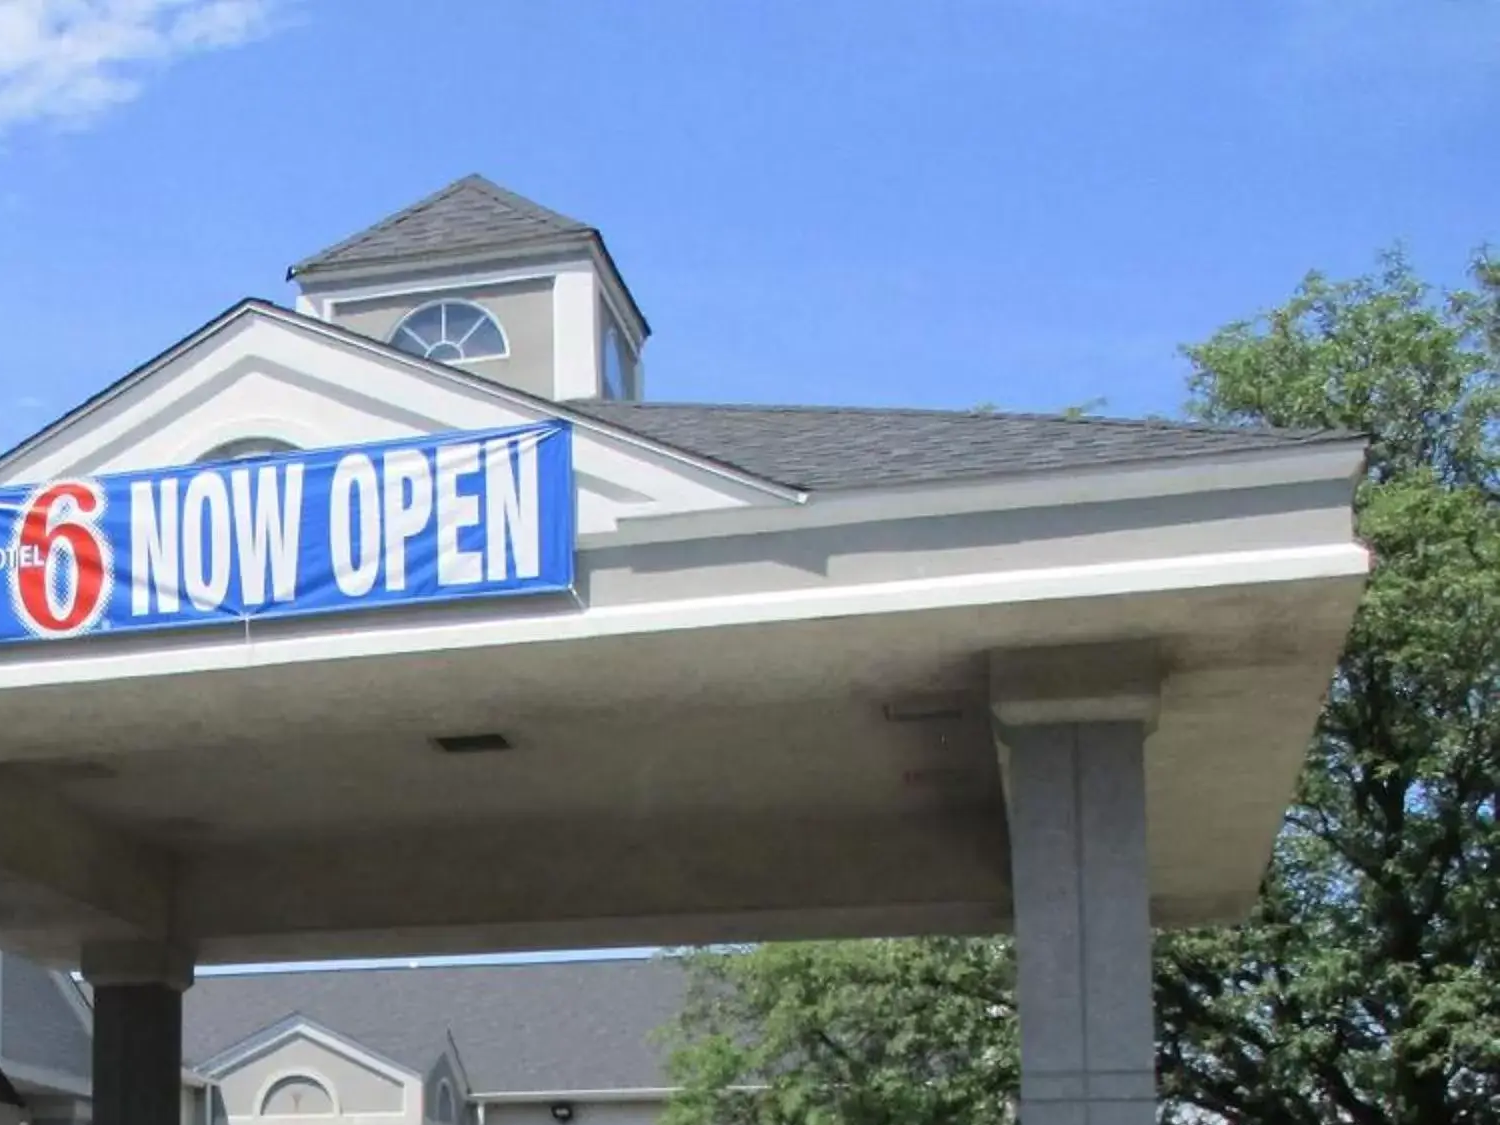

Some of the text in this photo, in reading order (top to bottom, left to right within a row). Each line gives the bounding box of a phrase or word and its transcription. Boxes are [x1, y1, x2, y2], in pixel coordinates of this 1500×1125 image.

[16, 481, 106, 633] 6
[131, 463, 305, 617] NOW
[330, 434, 540, 597] OPEN
